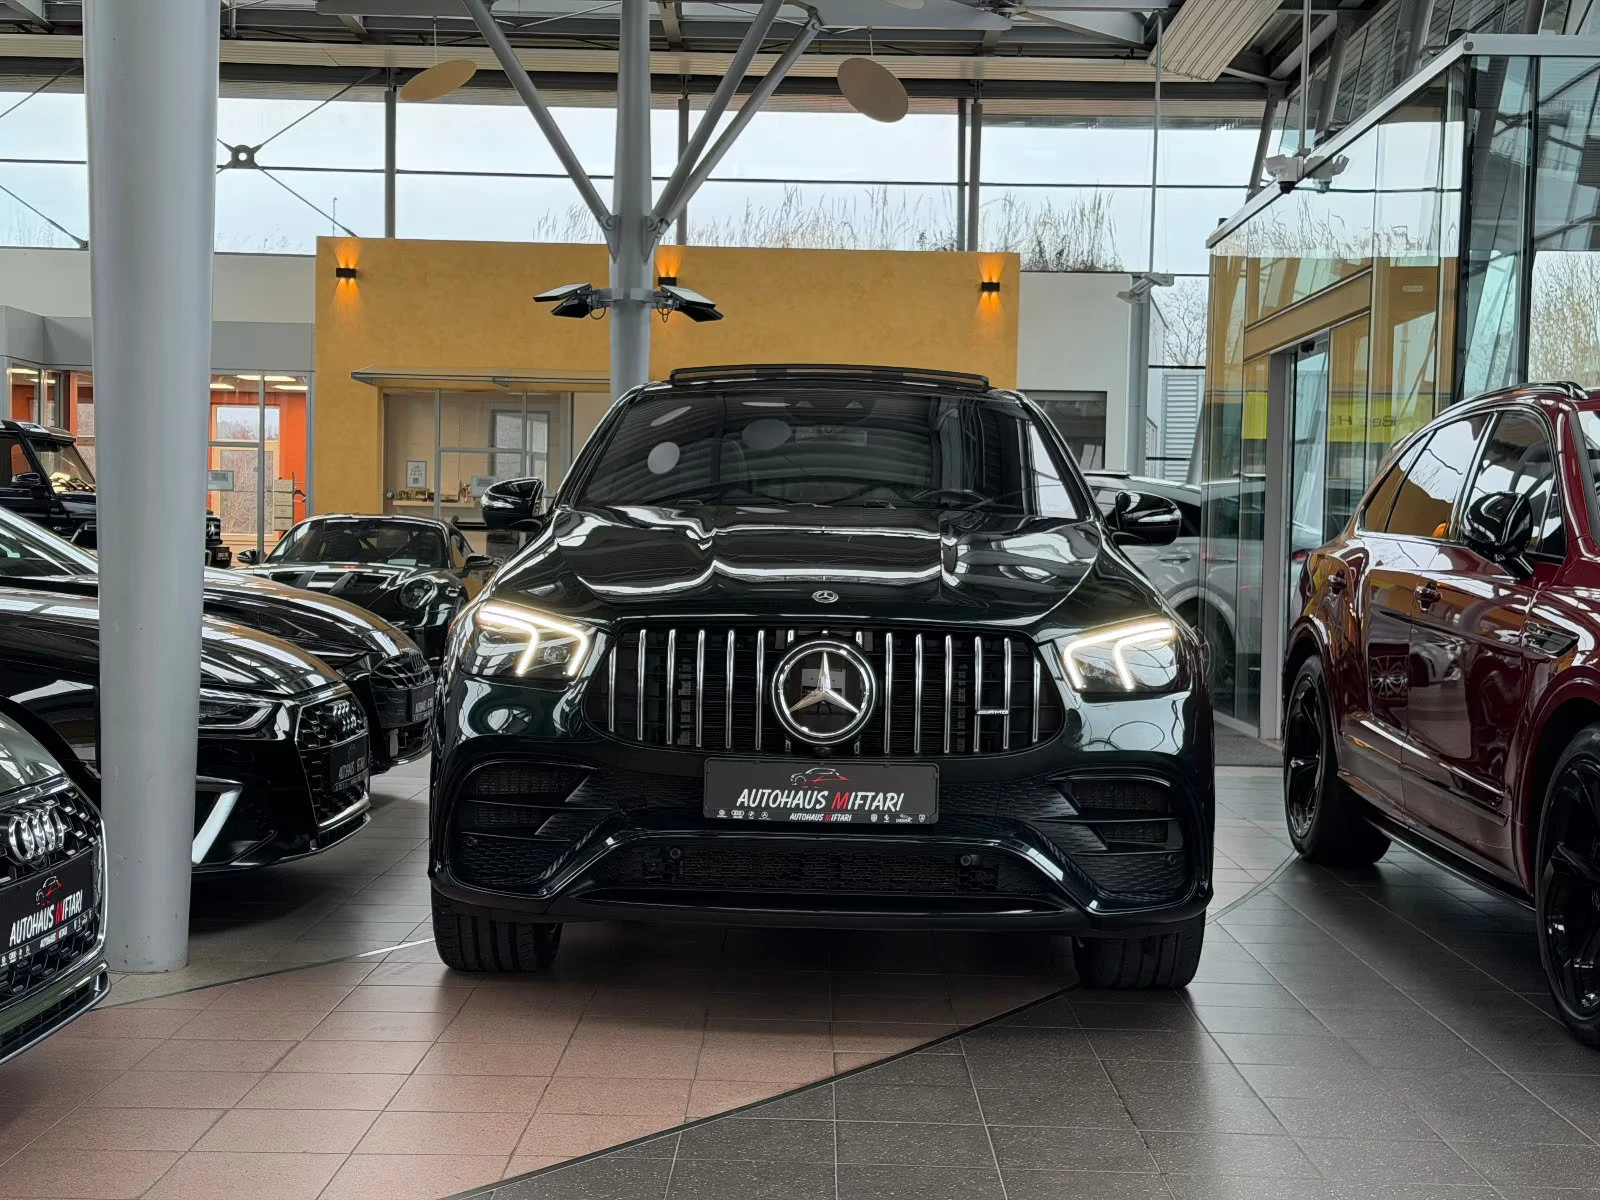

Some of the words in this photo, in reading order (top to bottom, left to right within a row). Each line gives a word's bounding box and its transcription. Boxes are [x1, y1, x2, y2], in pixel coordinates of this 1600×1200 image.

[736, 788, 828, 810] AUTOHAUS
[831, 791, 905, 812] MIFTARI
[789, 813, 824, 822] AUTOHAUS
[825, 813, 852, 823] MIFTARI
[9, 904, 55, 947] AUTOHAUS
[56, 889, 83, 925] MIFTARI
